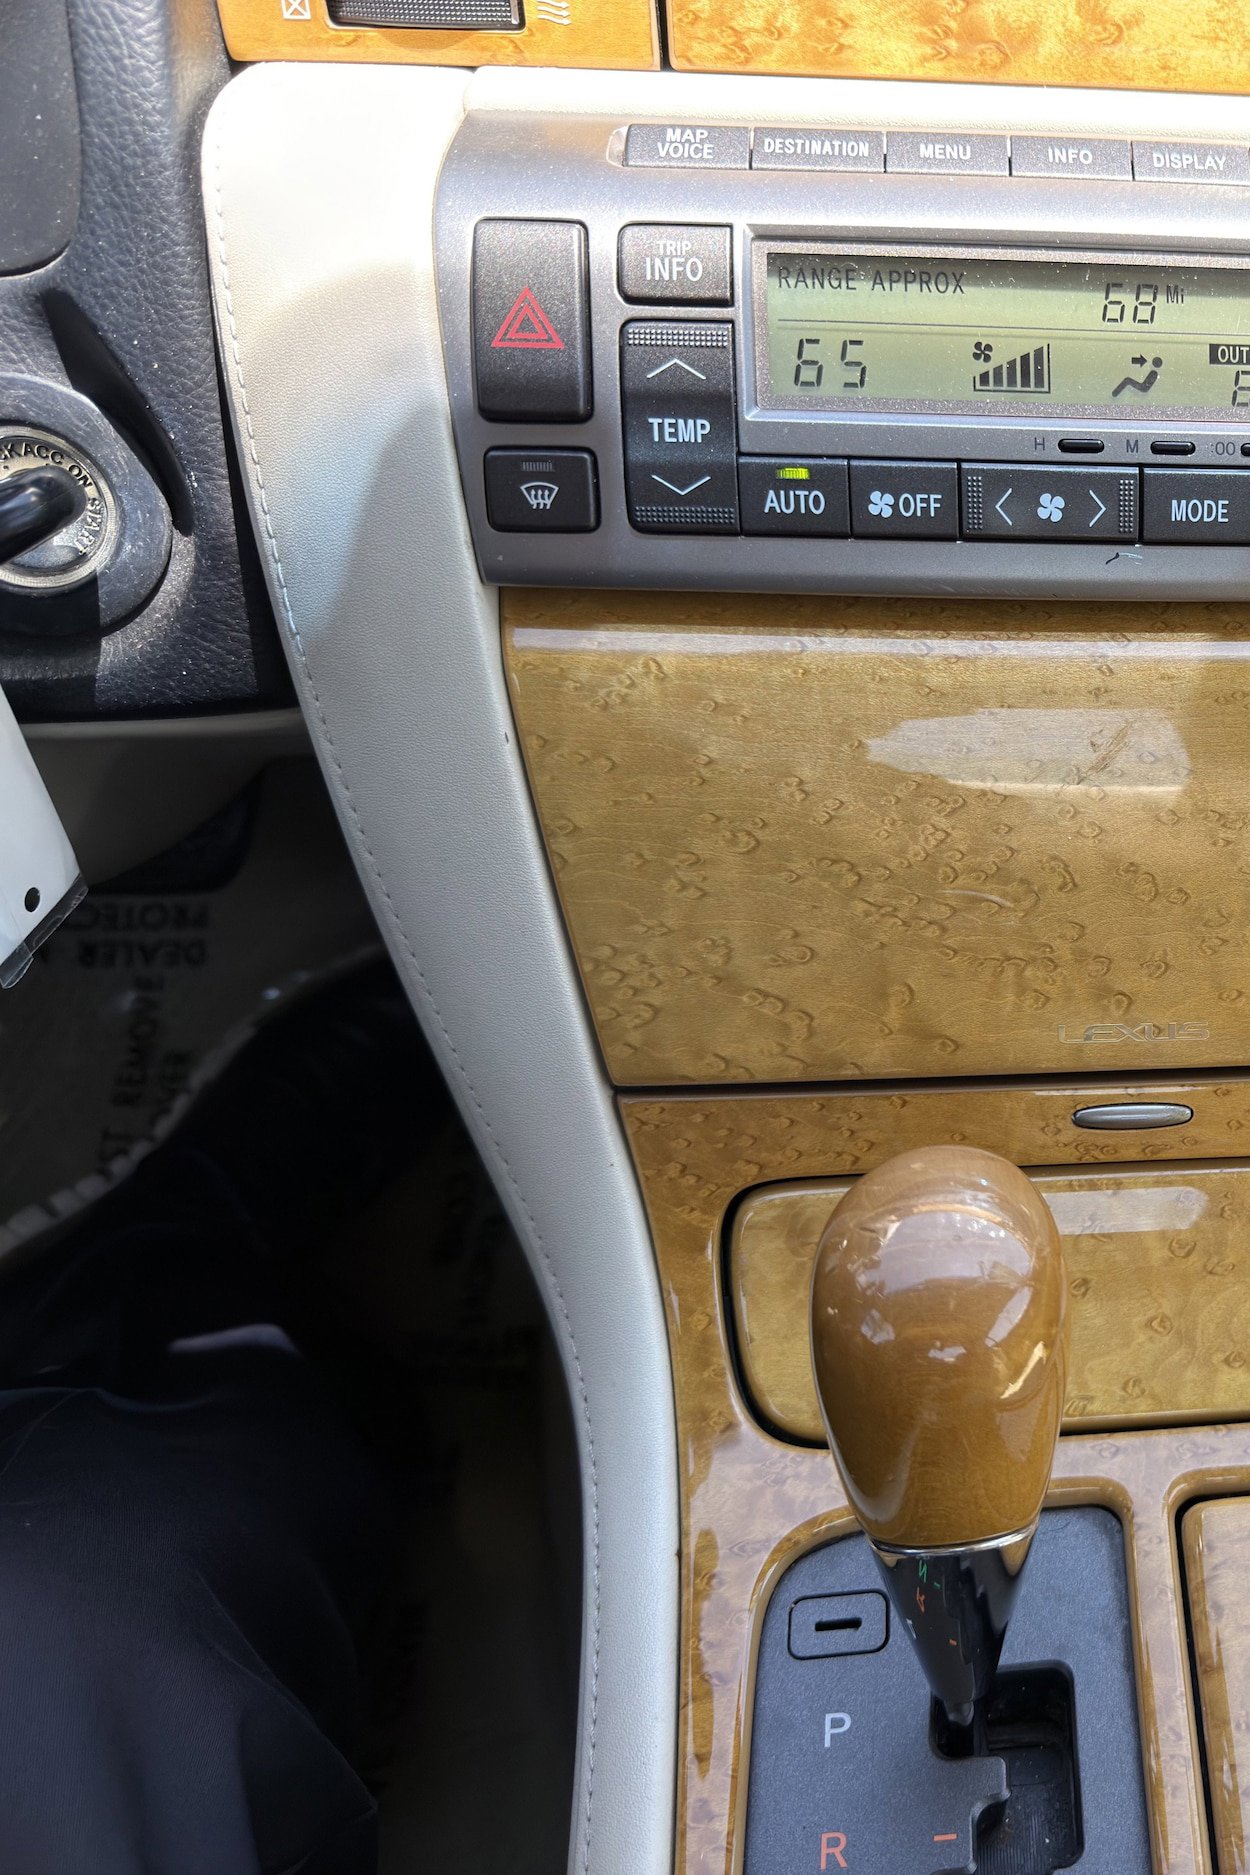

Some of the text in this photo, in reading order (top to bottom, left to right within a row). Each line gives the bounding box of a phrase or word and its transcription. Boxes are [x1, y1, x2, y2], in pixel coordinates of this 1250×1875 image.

[666, 127, 708, 142] MAP
[657, 140, 714, 160] VOICE
[763, 137, 870, 158] DESTINATION
[919, 143, 971, 161] MENU
[1047, 147, 1093, 165] INFO
[1152, 151, 1227, 172] DISPLAY
[656, 241, 692, 257] TRIP
[645, 257, 703, 282] INFO
[777, 267, 966, 296] RANGE APPROX
[1101, 281, 1157, 328] 68
[793, 337, 868, 389] 65
[1216, 346, 1248, 365] OUT
[648, 417, 712, 443] TEMP
[22, 441, 65, 466] ACC
[1033, 436, 1047, 452] H
[1125, 438, 1140, 455] M
[67, 464, 95, 490] ON
[763, 489, 826, 516] AUTO
[898, 493, 943, 519] OFF
[1170, 498, 1230, 524] MODE
[76, 496, 103, 557] START
[63, 902, 209, 931] PROTEC
[1057, 1021, 1211, 1044] LEXUS
[823, 1711, 852, 1748] P
[819, 1831, 849, 1871] R
